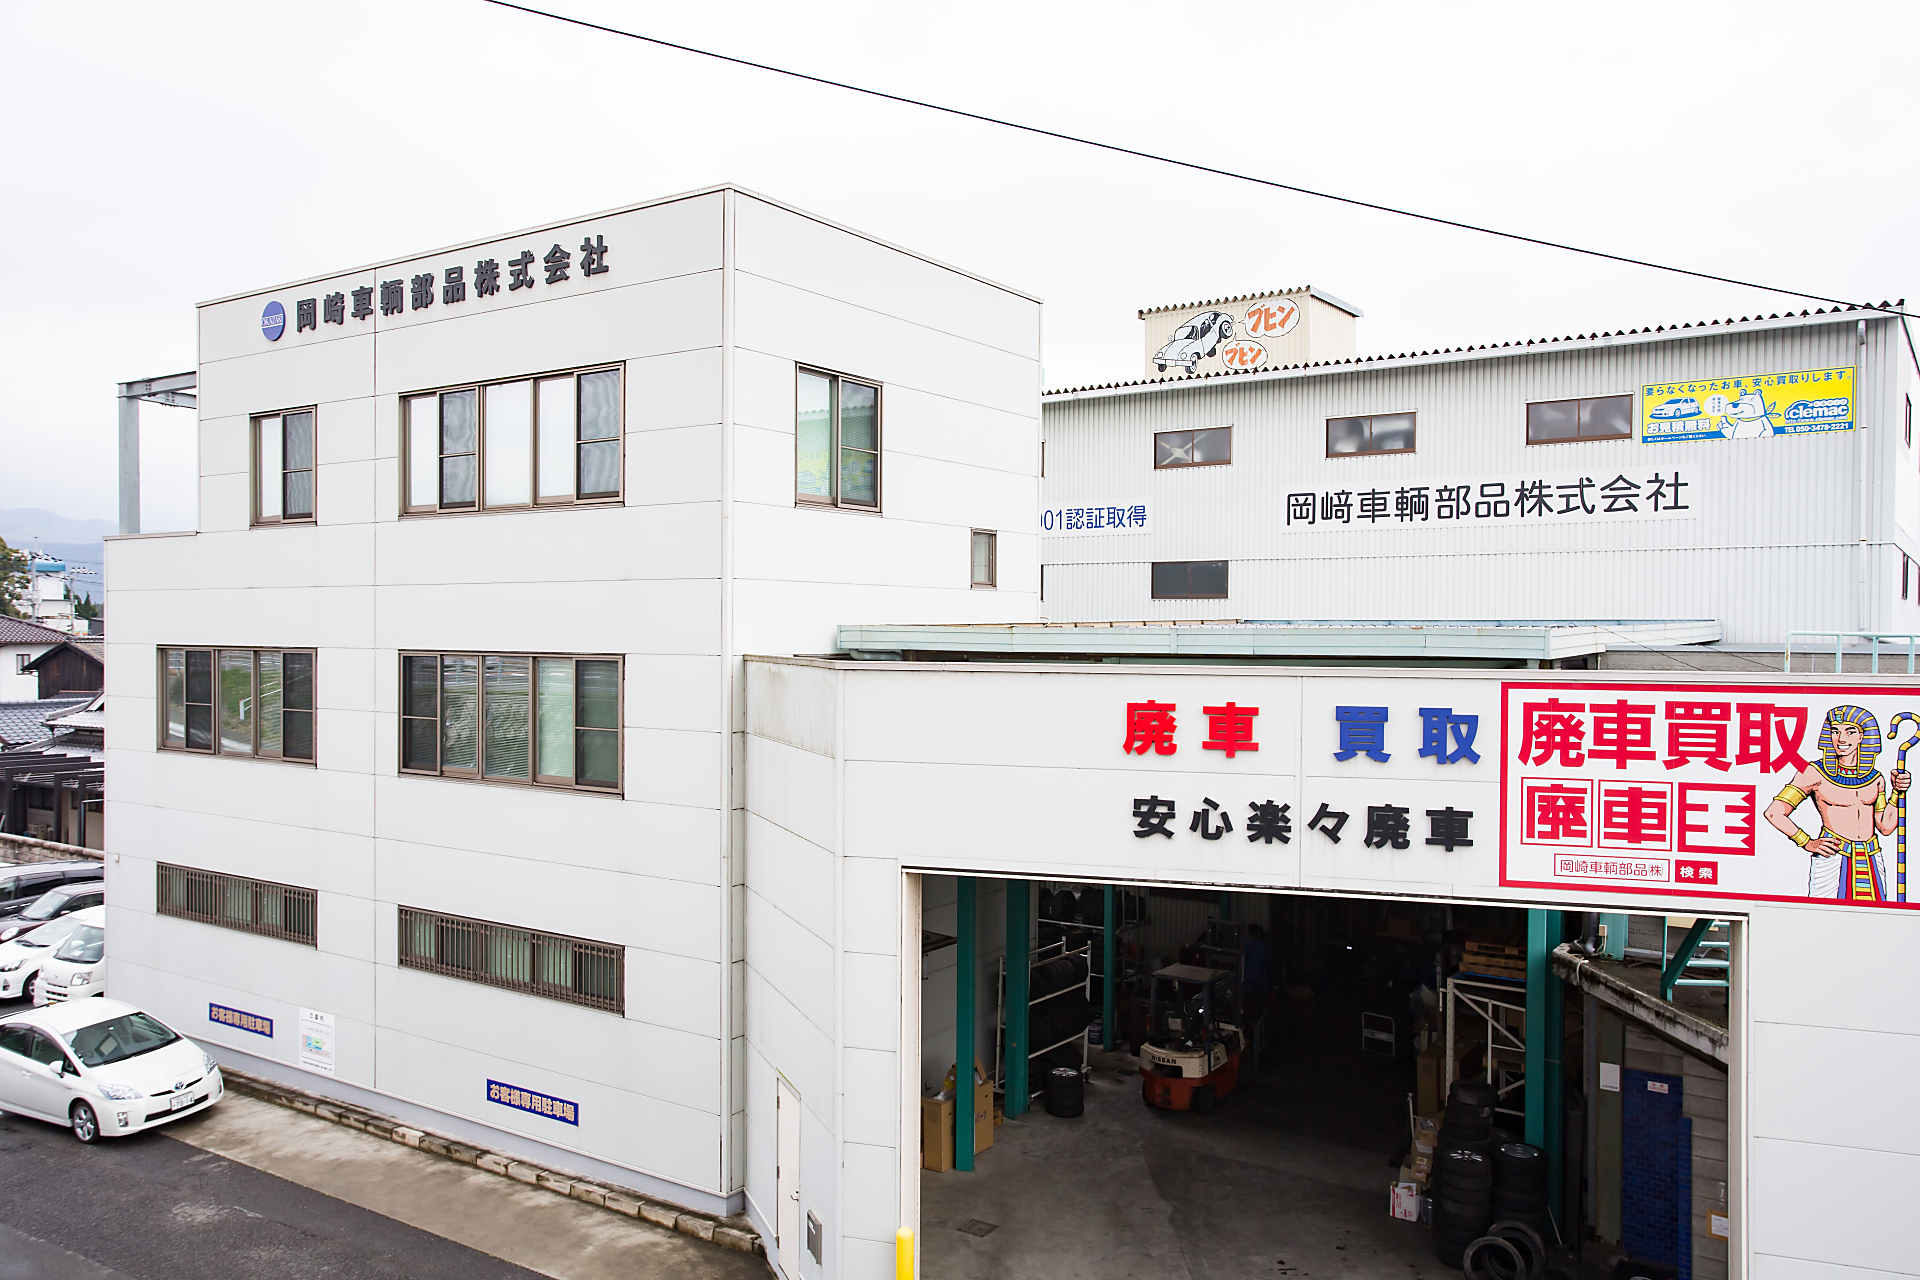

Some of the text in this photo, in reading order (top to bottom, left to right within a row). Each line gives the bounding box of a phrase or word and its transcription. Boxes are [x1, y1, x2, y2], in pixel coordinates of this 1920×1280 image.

[1247, 303, 1295, 333] ブヒン
[1225, 342, 1262, 366] ブヒン
[1041, 505, 1147, 530] 01認証取得
[1122, 699, 1482, 765] 廃車 買取
[1518, 697, 1809, 774] 廃車買取
[1132, 795, 1474, 853] 安心楽々廃車
[1679, 865, 1713, 880] 検索
[490, 1084, 575, 1122] お客様専用駐車場
